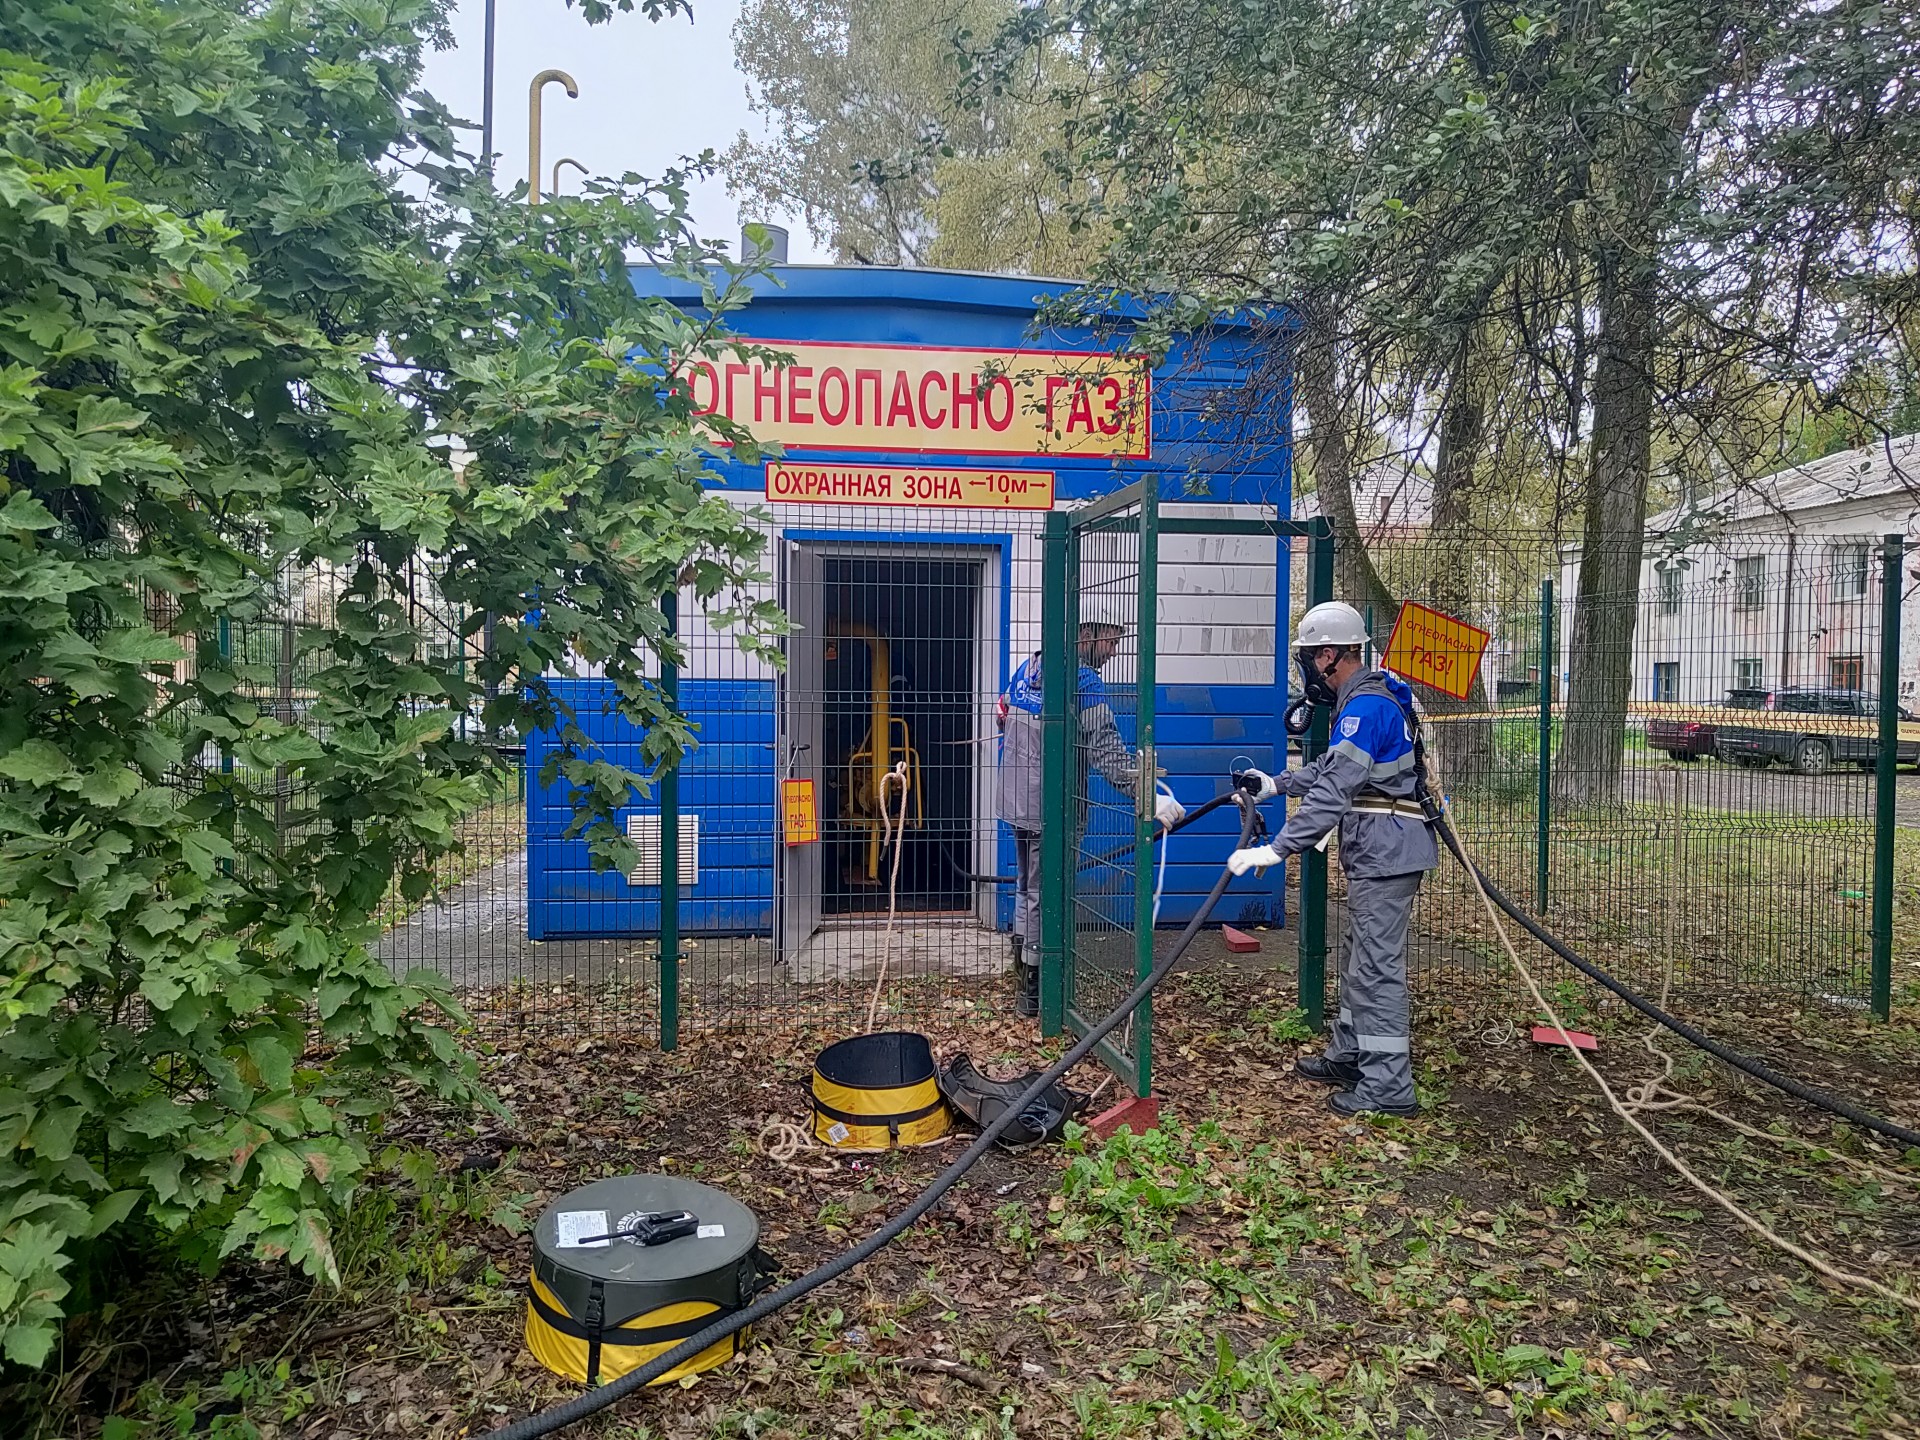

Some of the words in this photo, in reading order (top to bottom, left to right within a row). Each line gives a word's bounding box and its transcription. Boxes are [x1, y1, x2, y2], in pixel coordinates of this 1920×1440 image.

[687, 361, 1014, 431] ОГНЕОПАСНО
[1045, 376, 1136, 435] ГАЗ!
[774, 471, 891, 498] ОХРАННАЯ
[902, 474, 963, 499] ЗОНА
[1405, 620, 1475, 654] ОГНЕОПАСНО
[1410, 645, 1453, 675] ГАЗ!
[789, 812, 807, 830] ГАЗ!
